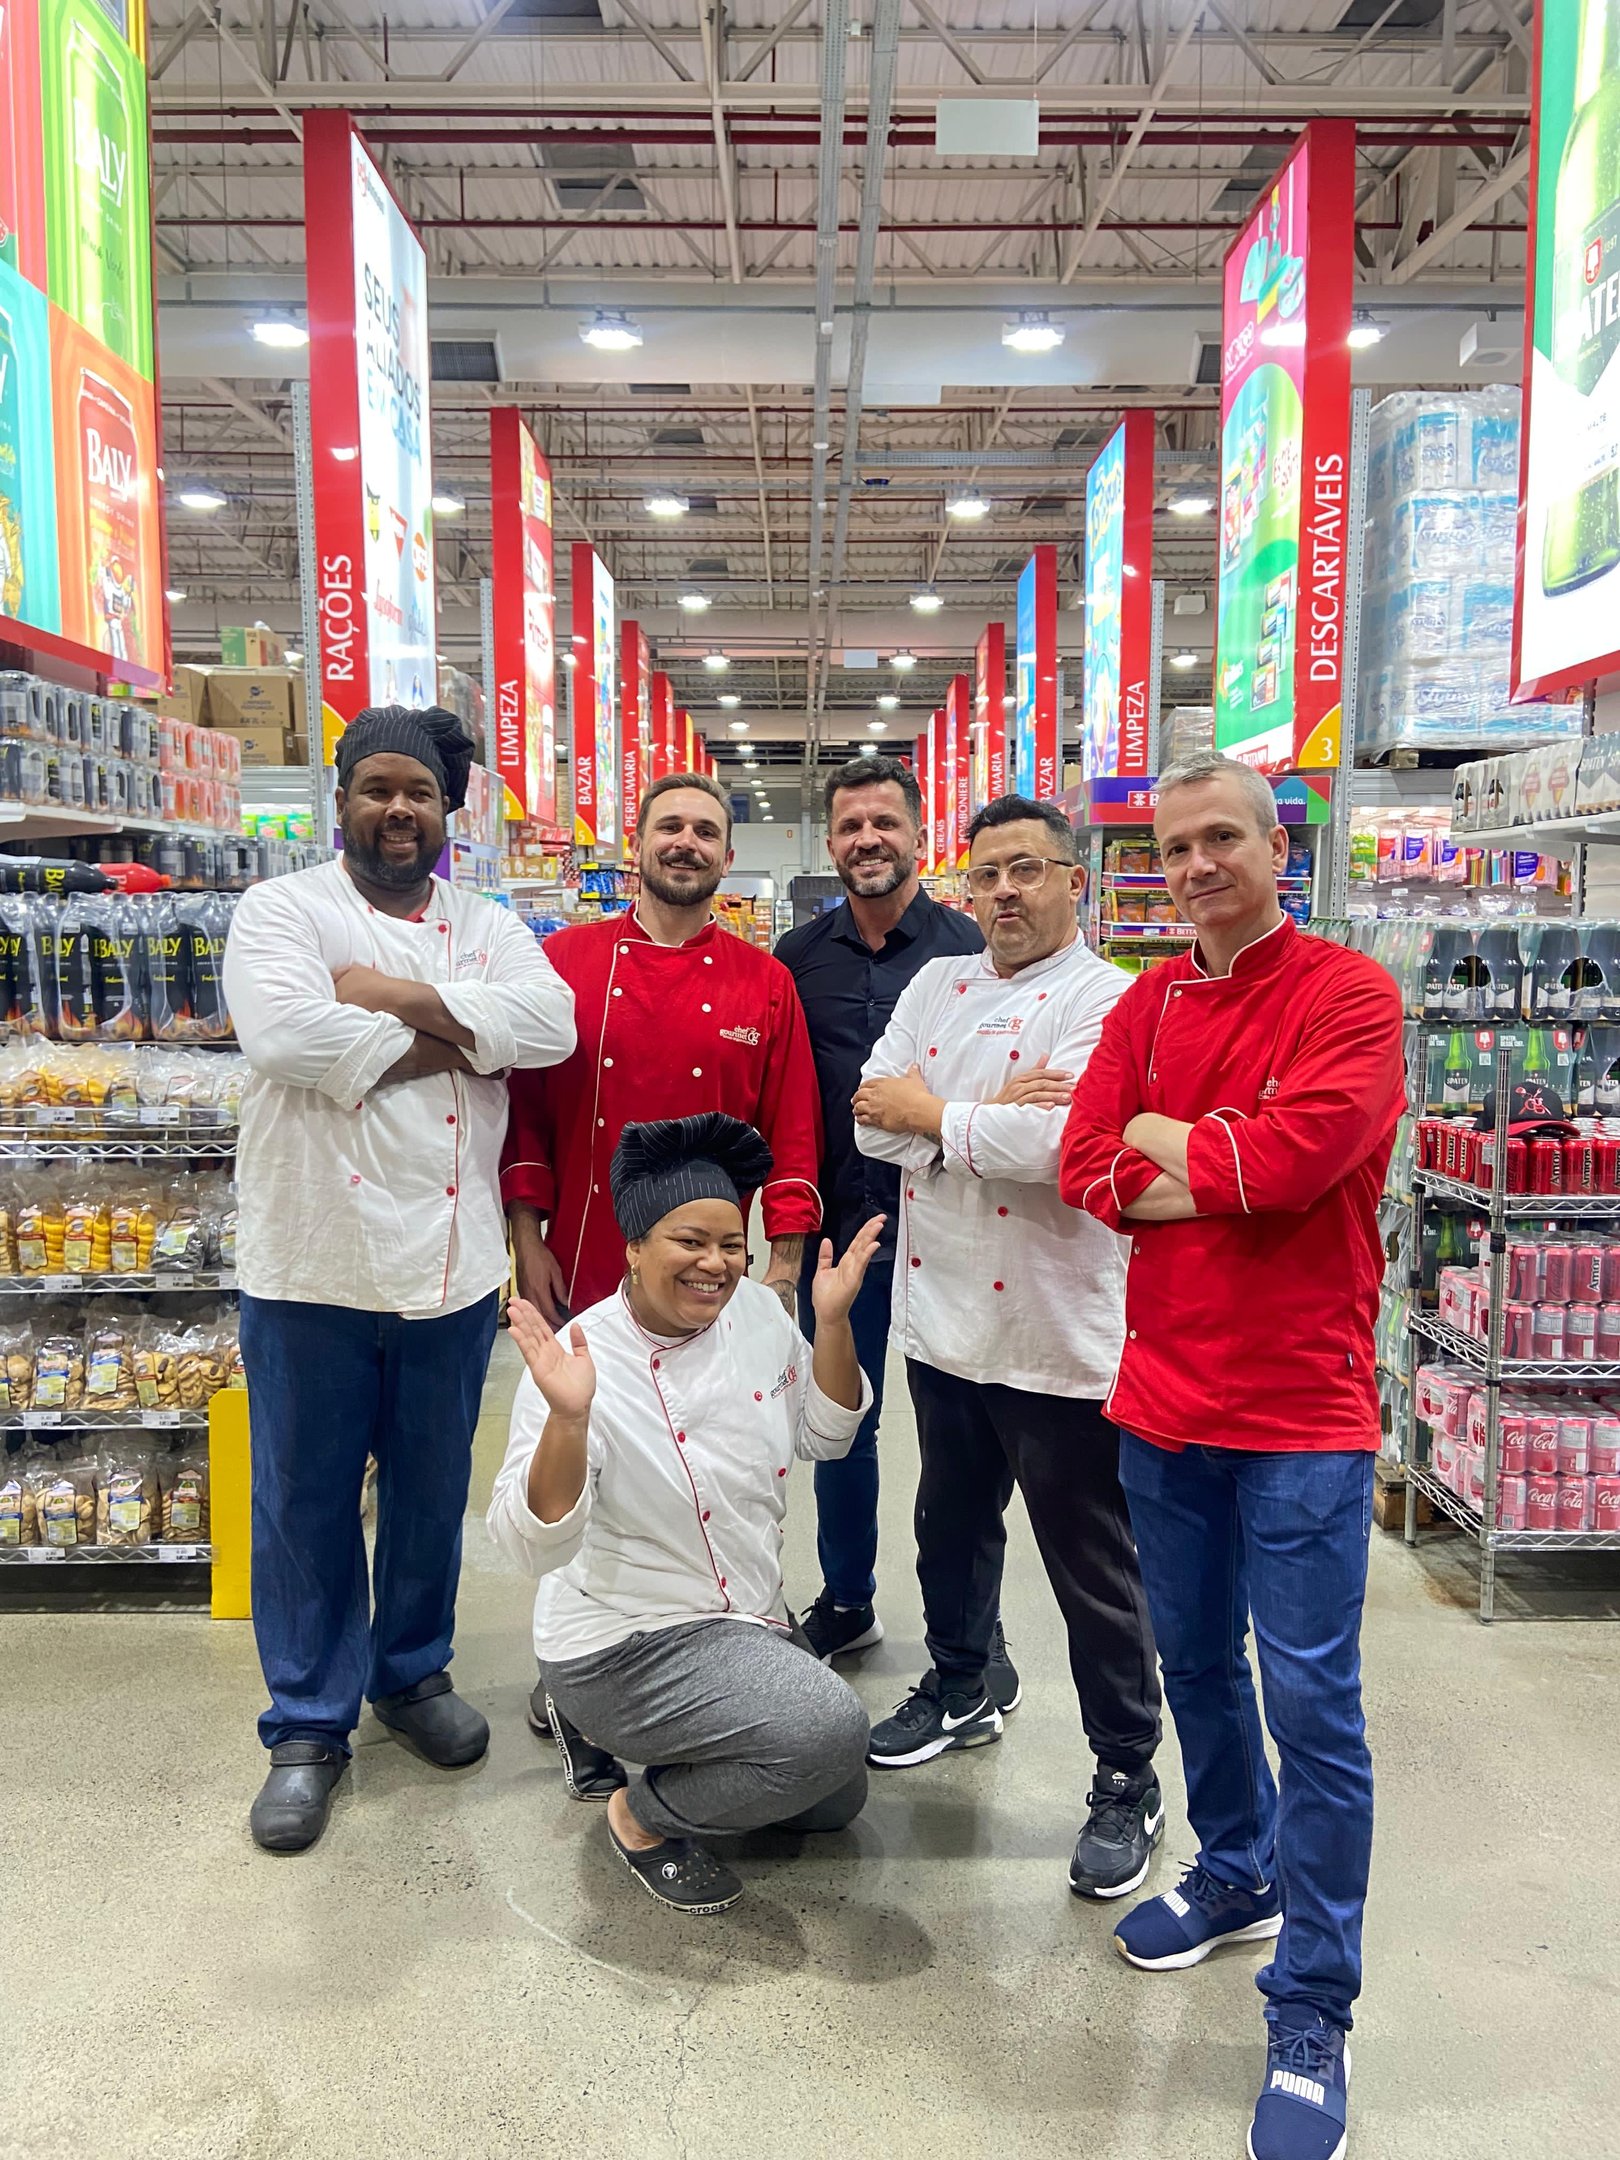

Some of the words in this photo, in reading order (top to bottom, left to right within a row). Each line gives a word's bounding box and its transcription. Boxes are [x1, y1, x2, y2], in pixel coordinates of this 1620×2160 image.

[364, 262, 400, 348] SEUS
[86, 427, 132, 503] BALY
[1307, 454, 1343, 681] DESCARTÁVEIS
[319, 554, 360, 681] RAÇÕES
[499, 679, 520, 766] LIMPEZA
[1124, 680, 1145, 768] LIMPEZA
[1320, 737, 1334, 762] 3
[578, 756, 592, 805] BAZAR
[625, 750, 636, 827] PERFUMARIA
[1284, 797, 1306, 805] vida.
[578, 831, 585, 843] 5
[936, 819, 945, 854] CEREAIS
[41, 935, 76, 957] BLY
[100, 938, 135, 958] BALY
[147, 936, 182, 957] BALY
[994, 1016, 1011, 1024] chef
[1446, 1077, 1468, 1085] SPATEN
[1550, 1149, 1561, 1187] Amor
[1581, 1147, 1592, 1189] Amigos
[1587, 1255, 1601, 1292] Amor
[555, 1729, 568, 1759] crocs
[689, 1903, 727, 1914] crocs
[1270, 2070, 1325, 2106] PUMA
